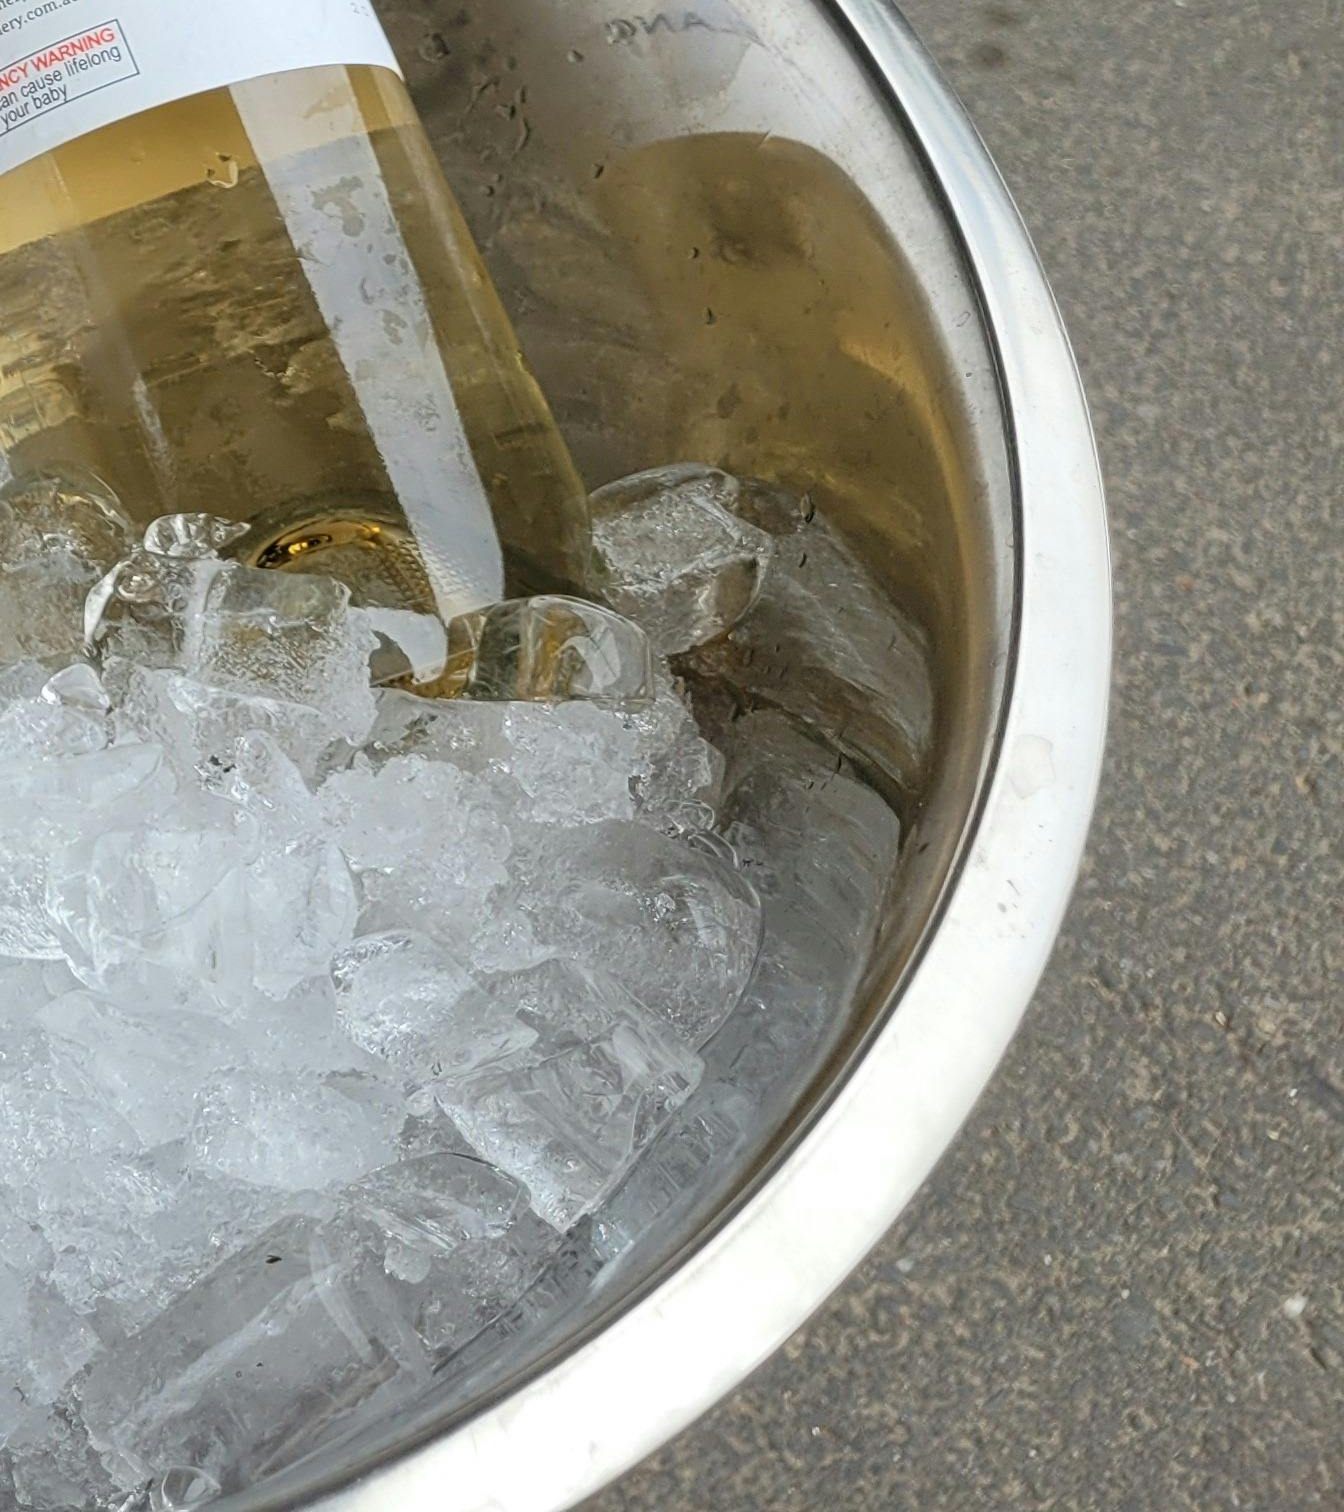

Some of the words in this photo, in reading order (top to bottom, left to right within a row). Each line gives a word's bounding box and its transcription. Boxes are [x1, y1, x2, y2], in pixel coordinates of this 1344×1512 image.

[20, 69, 63, 98] cause
[63, 45, 122, 77] lifelong
[29, 27, 116, 72] WARNING
[0, 101, 30, 132] your
[32, 83, 69, 111] baby
